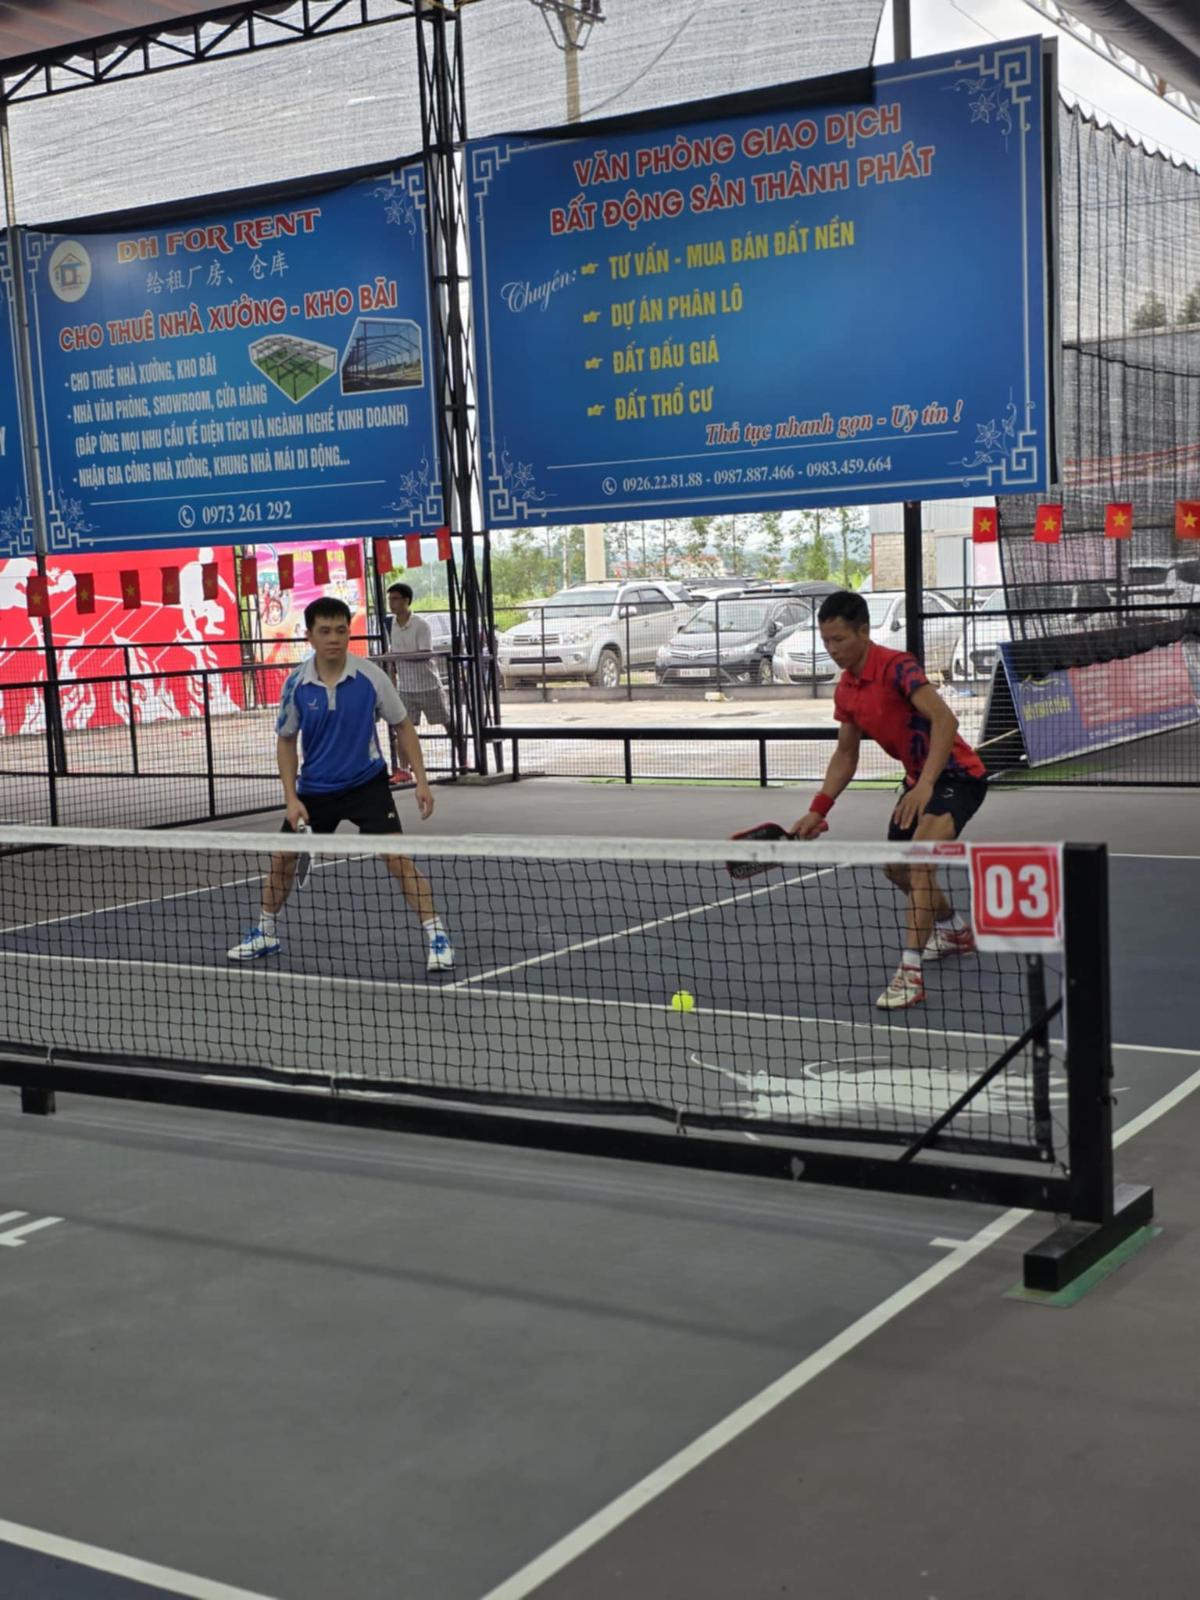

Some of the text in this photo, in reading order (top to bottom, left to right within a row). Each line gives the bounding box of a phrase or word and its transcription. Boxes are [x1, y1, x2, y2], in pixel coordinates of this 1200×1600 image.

[574, 103, 901, 186] VĂN PHÒNG GIAO DỊCH
[551, 141, 935, 235] BẤT ĐỘNG SẢN THÀNH PHÁT
[117, 208, 322, 264] DH FOR RENT
[609, 252, 631, 280] TƯ
[634, 242, 669, 276] VẤN
[686, 240, 726, 269] MUA
[731, 230, 769, 263] BÁN
[774, 219, 809, 257] ĐẤT
[815, 214, 855, 250] NỀN
[60, 322, 104, 351] CHO
[107, 309, 154, 346] THUÊ
[159, 301, 204, 338] NHÀ
[208, 293, 285, 332] XƯỞNG
[304, 288, 353, 320] KHO
[359, 276, 398, 312] BÃI
[500, 269, 577, 313] Chuyên:
[611, 282, 743, 330] DỰ ÁN PHÂN LÔ
[70, 372, 89, 392] CHO
[91, 364, 115, 390] THUÊ
[116, 362, 137, 386] NHÀ
[176, 358, 197, 379] KHO
[199, 352, 217, 376] BÃI
[613, 334, 719, 374] ĐẤT ĐẤU GIÁ
[72, 400, 93, 424] NHÀ
[94, 398, 115, 420] VĂN
[115, 394, 152, 419] PHÒNG,
[153, 389, 215, 416] SHOWROOM,
[215, 381, 237, 409] CỬA
[239, 381, 267, 406] HÀNG
[615, 382, 714, 421] ĐẤT THỔ CƯ
[705, 421, 740, 446] Thủ
[744, 423, 772, 447] tục
[775, 412, 833, 439] nhanh
[836, 414, 873, 439] gọn
[922, 401, 948, 426] tín
[121, 431, 141, 455] MỌI
[142, 428, 162, 450] NHU
[200, 419, 224, 448] DIỆN
[226, 416, 249, 441] TÍCH
[251, 414, 265, 439] VÀ
[267, 412, 303, 437] NGÀNH
[337, 408, 364, 431] KINH
[366, 404, 409, 428] DOANH)
[79, 464, 105, 490] NHẬN
[106, 465, 123, 485] GIA
[124, 460, 150, 482] CÔNG
[153, 456, 174, 481] NHÀ
[213, 454, 248, 477] KHUNG
[250, 448, 272, 473] NHÀ
[274, 446, 295, 471] MÁI
[297, 449, 309, 469] DI
[623, 472, 703, 492] 0926.22.81.88
[713, 464, 795, 485] 0987.887.466
[806, 456, 892, 478] 0983.459.664
[202, 500, 293, 524] 0973 261 292
[985, 863, 1050, 919] 03
